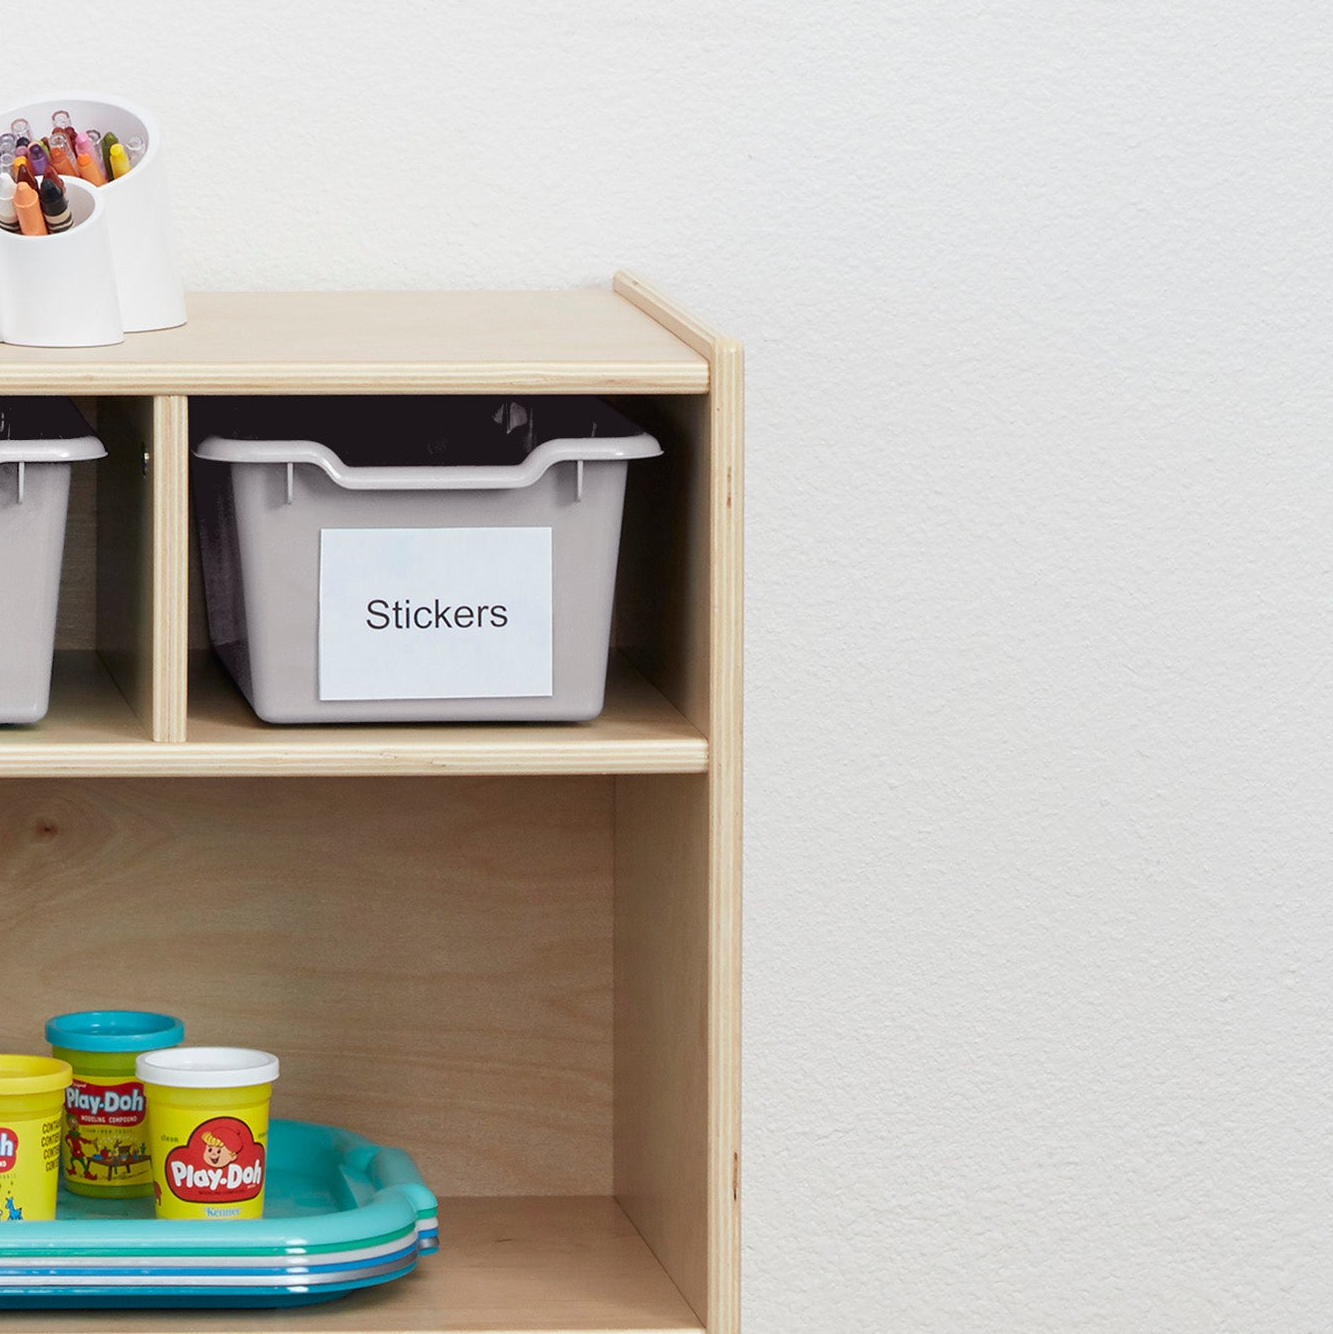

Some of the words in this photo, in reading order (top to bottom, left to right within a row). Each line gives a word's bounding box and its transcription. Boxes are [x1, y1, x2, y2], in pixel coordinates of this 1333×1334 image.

[366, 599, 508, 630] Stickers
[65, 1086, 144, 1115] Play-Doh
[170, 1158, 262, 1191] Play-Doh
